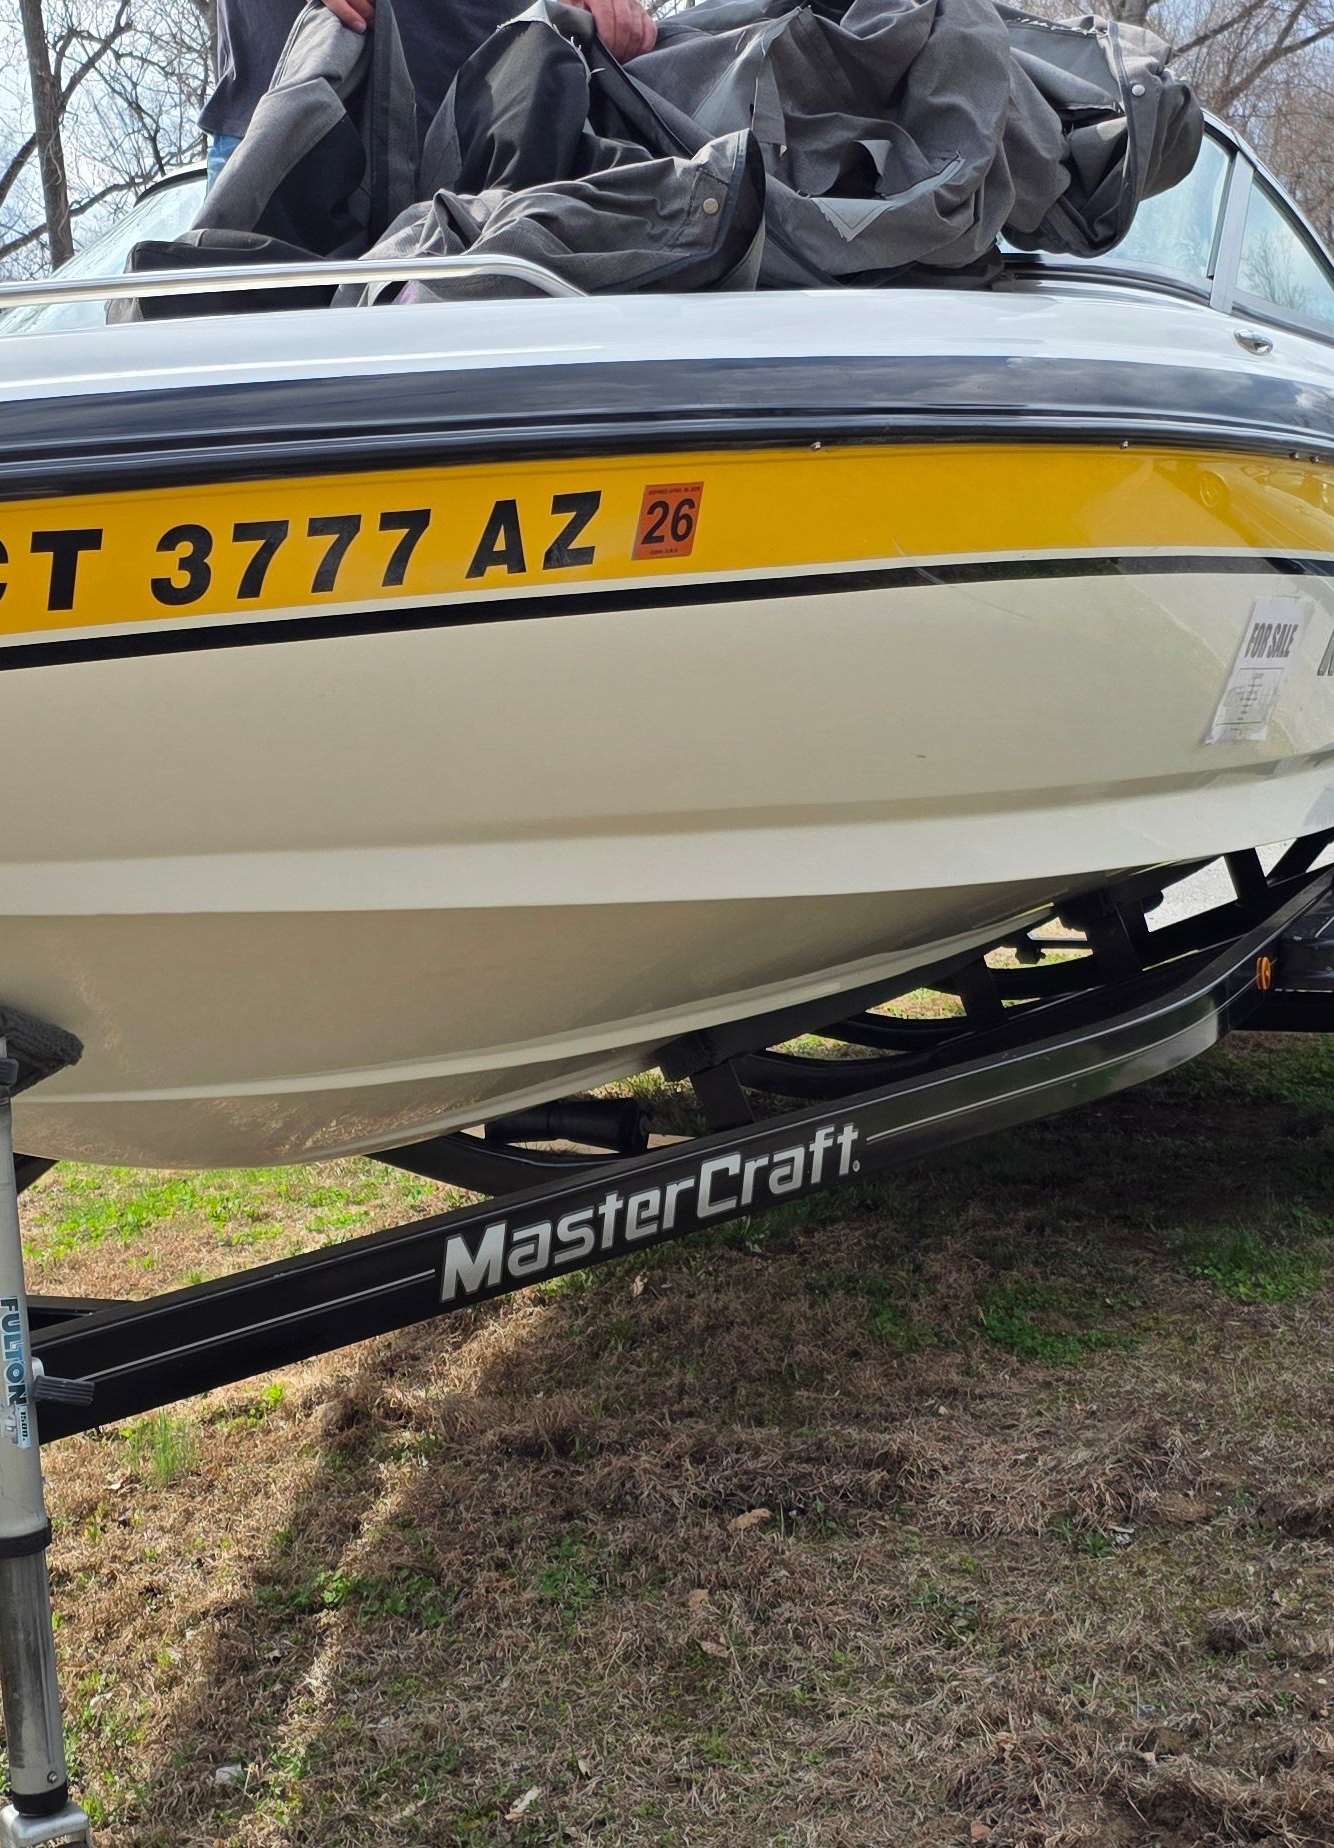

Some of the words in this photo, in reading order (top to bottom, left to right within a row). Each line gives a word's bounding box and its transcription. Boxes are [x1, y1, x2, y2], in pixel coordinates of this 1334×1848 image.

[150, 508, 432, 607] 3777
[464, 490, 602, 579] AZ
[641, 498, 696, 545] 26
[1244, 622, 1272, 658] FOR
[1266, 622, 1299, 660] SALE
[439, 1121, 859, 1303] MasterCraft
[0, 1296, 28, 1406] FULTON
